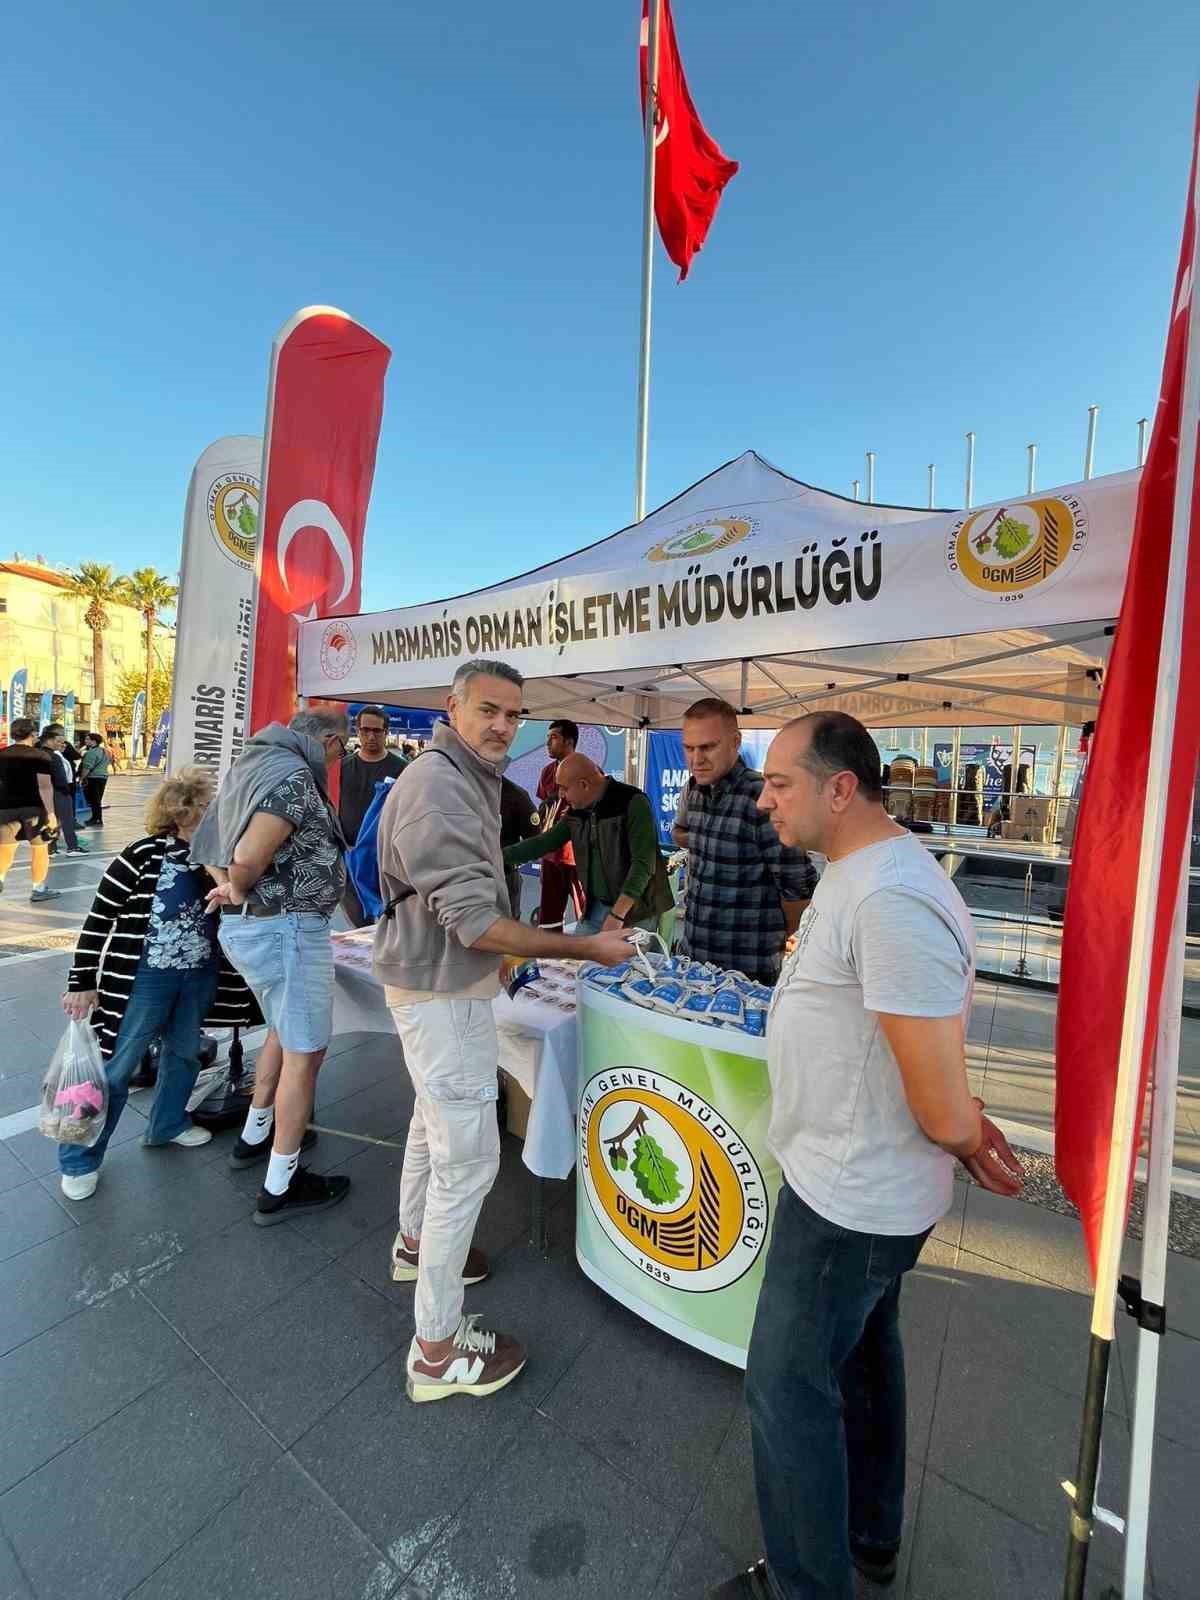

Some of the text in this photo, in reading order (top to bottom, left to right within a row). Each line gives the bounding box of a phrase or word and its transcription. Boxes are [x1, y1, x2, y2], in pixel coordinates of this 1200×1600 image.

[982, 567, 1015, 583] OGM
[371, 609, 462, 665] MARMARİS
[465, 606, 543, 655] ORMAN
[548, 590, 651, 656] İŞLETME
[657, 530, 883, 630] MÜDÜRLÜĞÜ
[598, 1073, 661, 1092] GENEL
[676, 1091, 765, 1249] MÜDÜRLÜĞÜ
[616, 1194, 658, 1245] OGM
[637, 1257, 671, 1282] 1839
